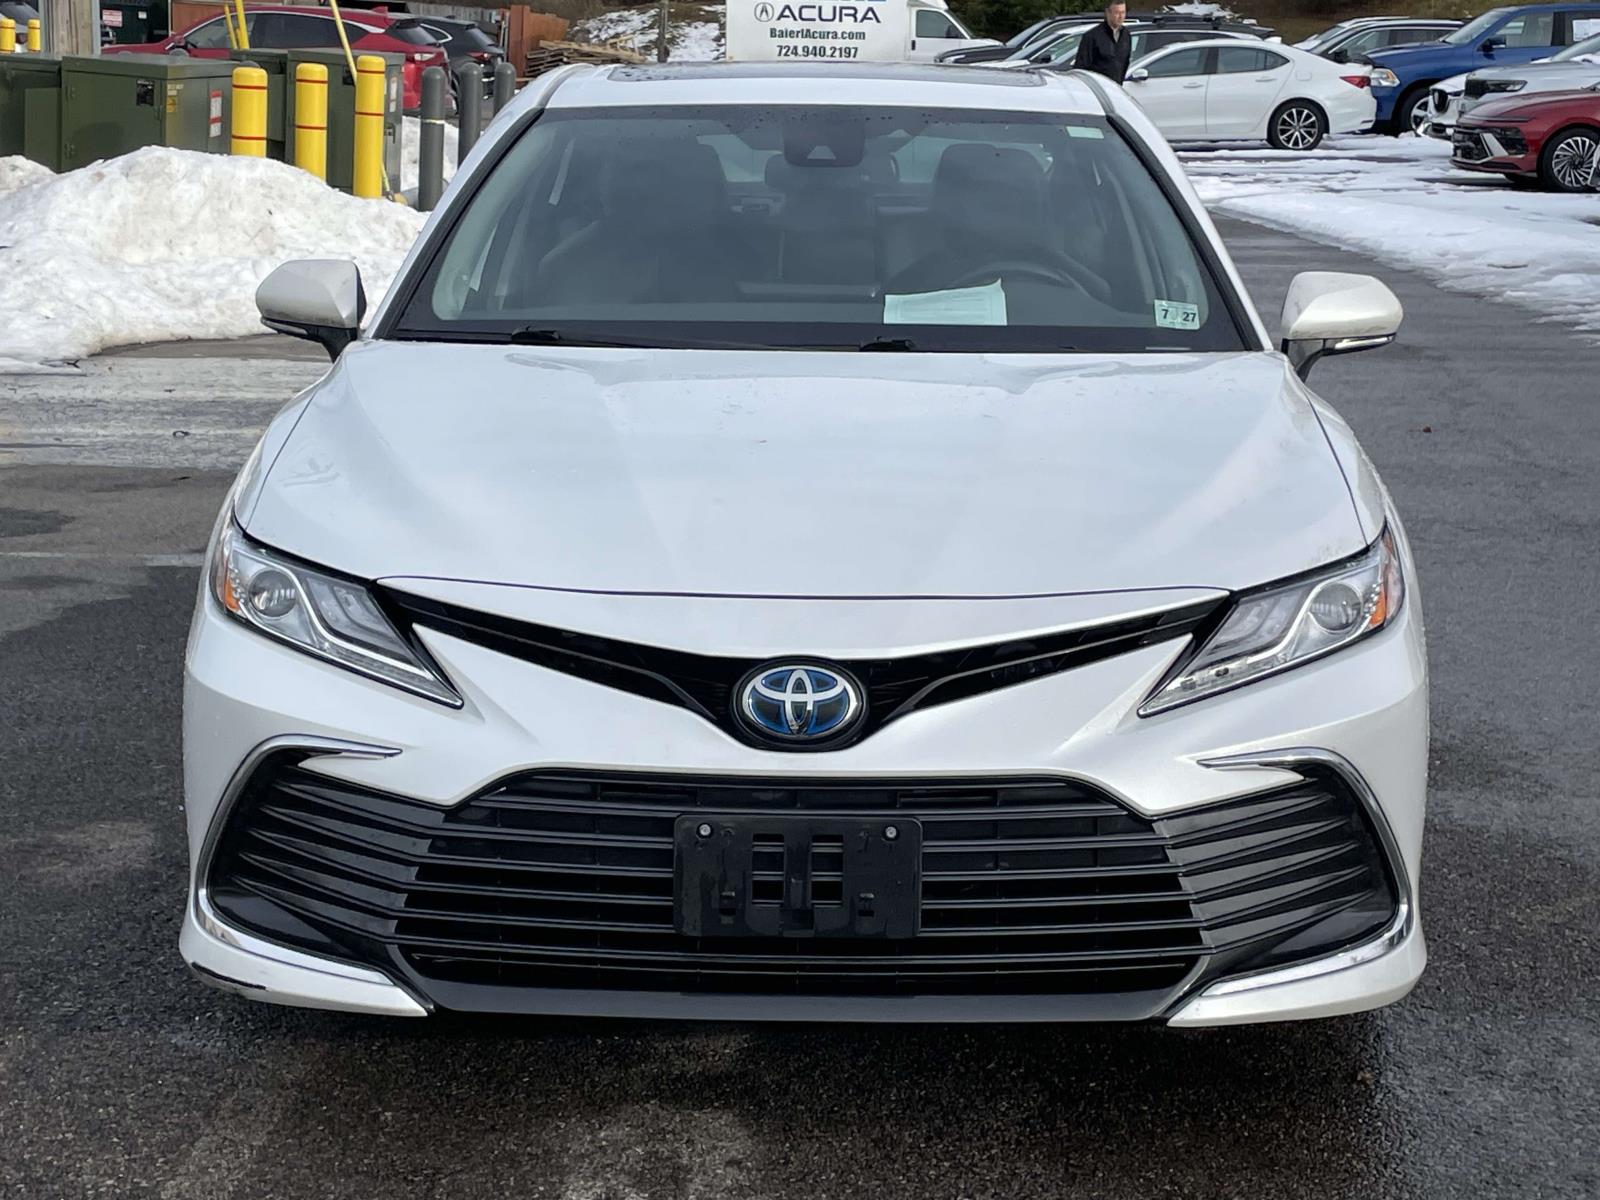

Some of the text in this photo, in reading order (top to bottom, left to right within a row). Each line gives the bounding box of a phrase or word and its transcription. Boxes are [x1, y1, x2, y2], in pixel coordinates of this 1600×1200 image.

[776, 4, 881, 23] ACURA
[769, 27, 866, 40] BaierlAcura.com
[776, 45, 859, 58] 724.940.2197
[1162, 309, 1197, 322] 7 27
